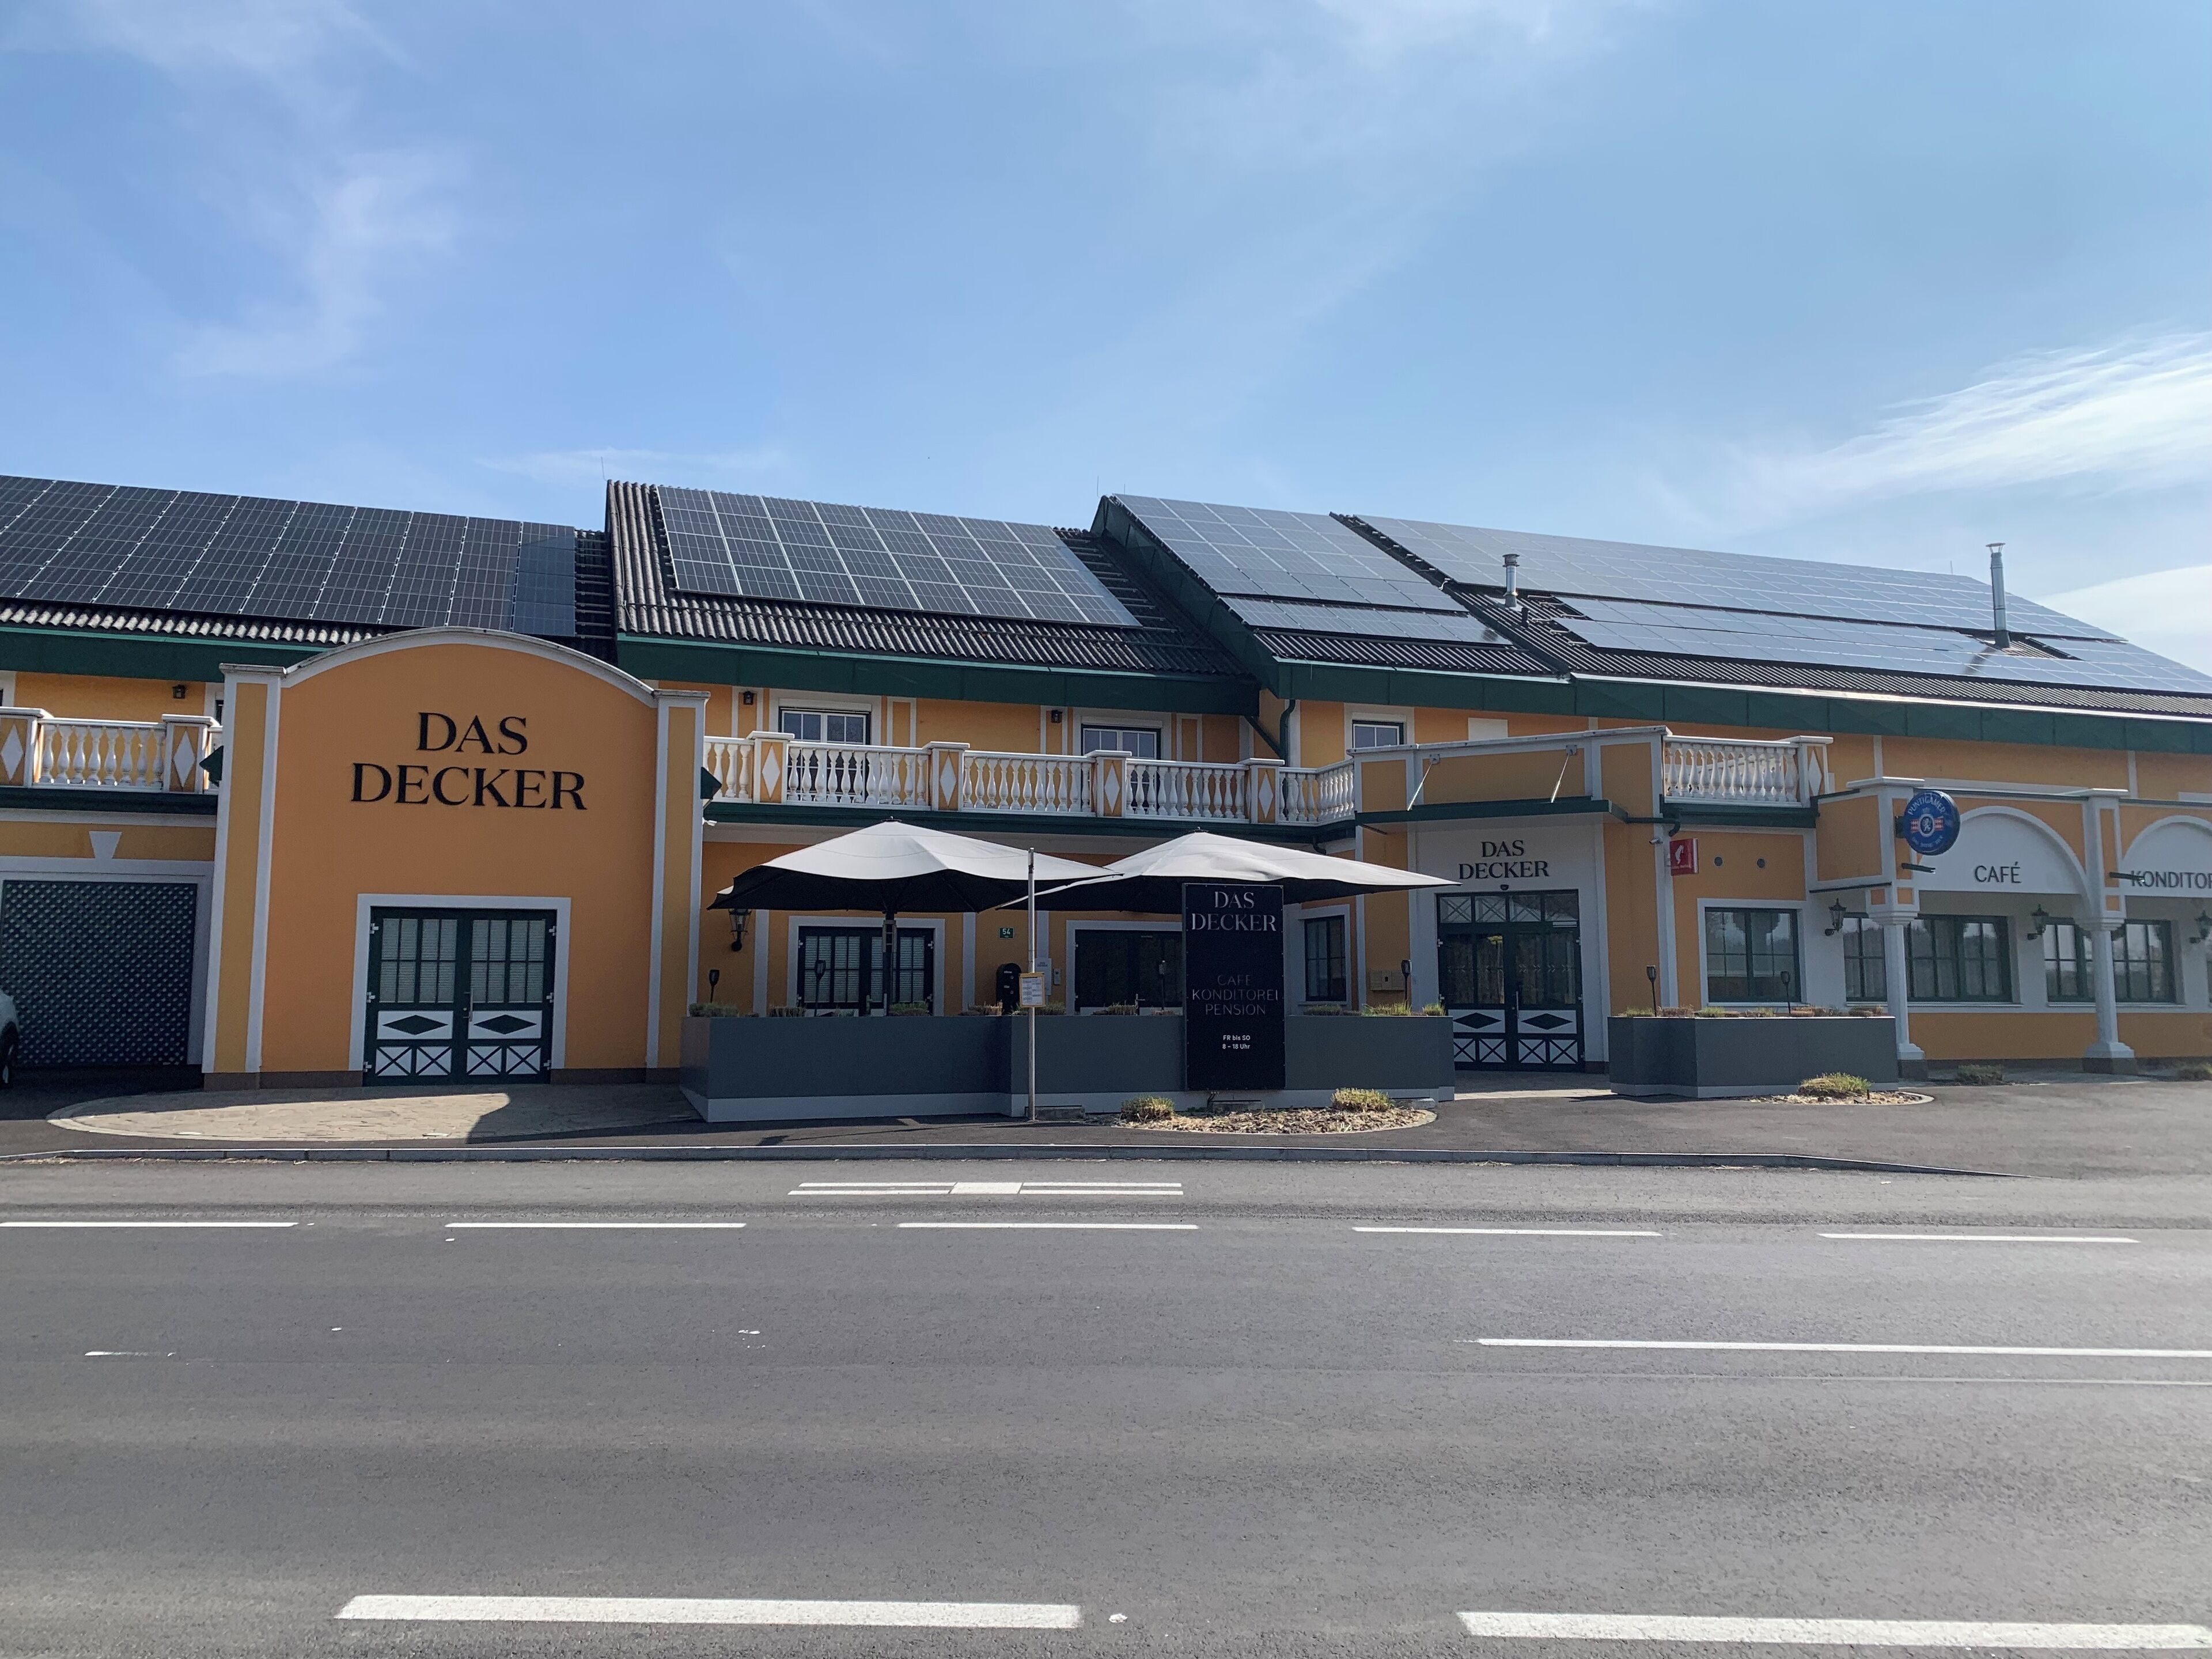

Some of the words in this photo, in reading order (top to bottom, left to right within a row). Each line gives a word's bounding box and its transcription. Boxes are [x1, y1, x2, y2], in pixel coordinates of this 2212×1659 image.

[416, 711, 528, 755] DAS
[351, 762, 588, 810] DECKER
[1907, 796, 1946, 815] PUNTIGAMER
[1481, 839, 1525, 857] DAS
[1459, 860, 1550, 879] DECKER
[1974, 861, 2022, 883] CAFÉ
[1214, 891, 1255, 908] DAS
[1191, 913, 1277, 931] DECKER
[1192, 988, 1278, 1001] KONDITOREI
[1206, 1003, 1266, 1016] PENSION
